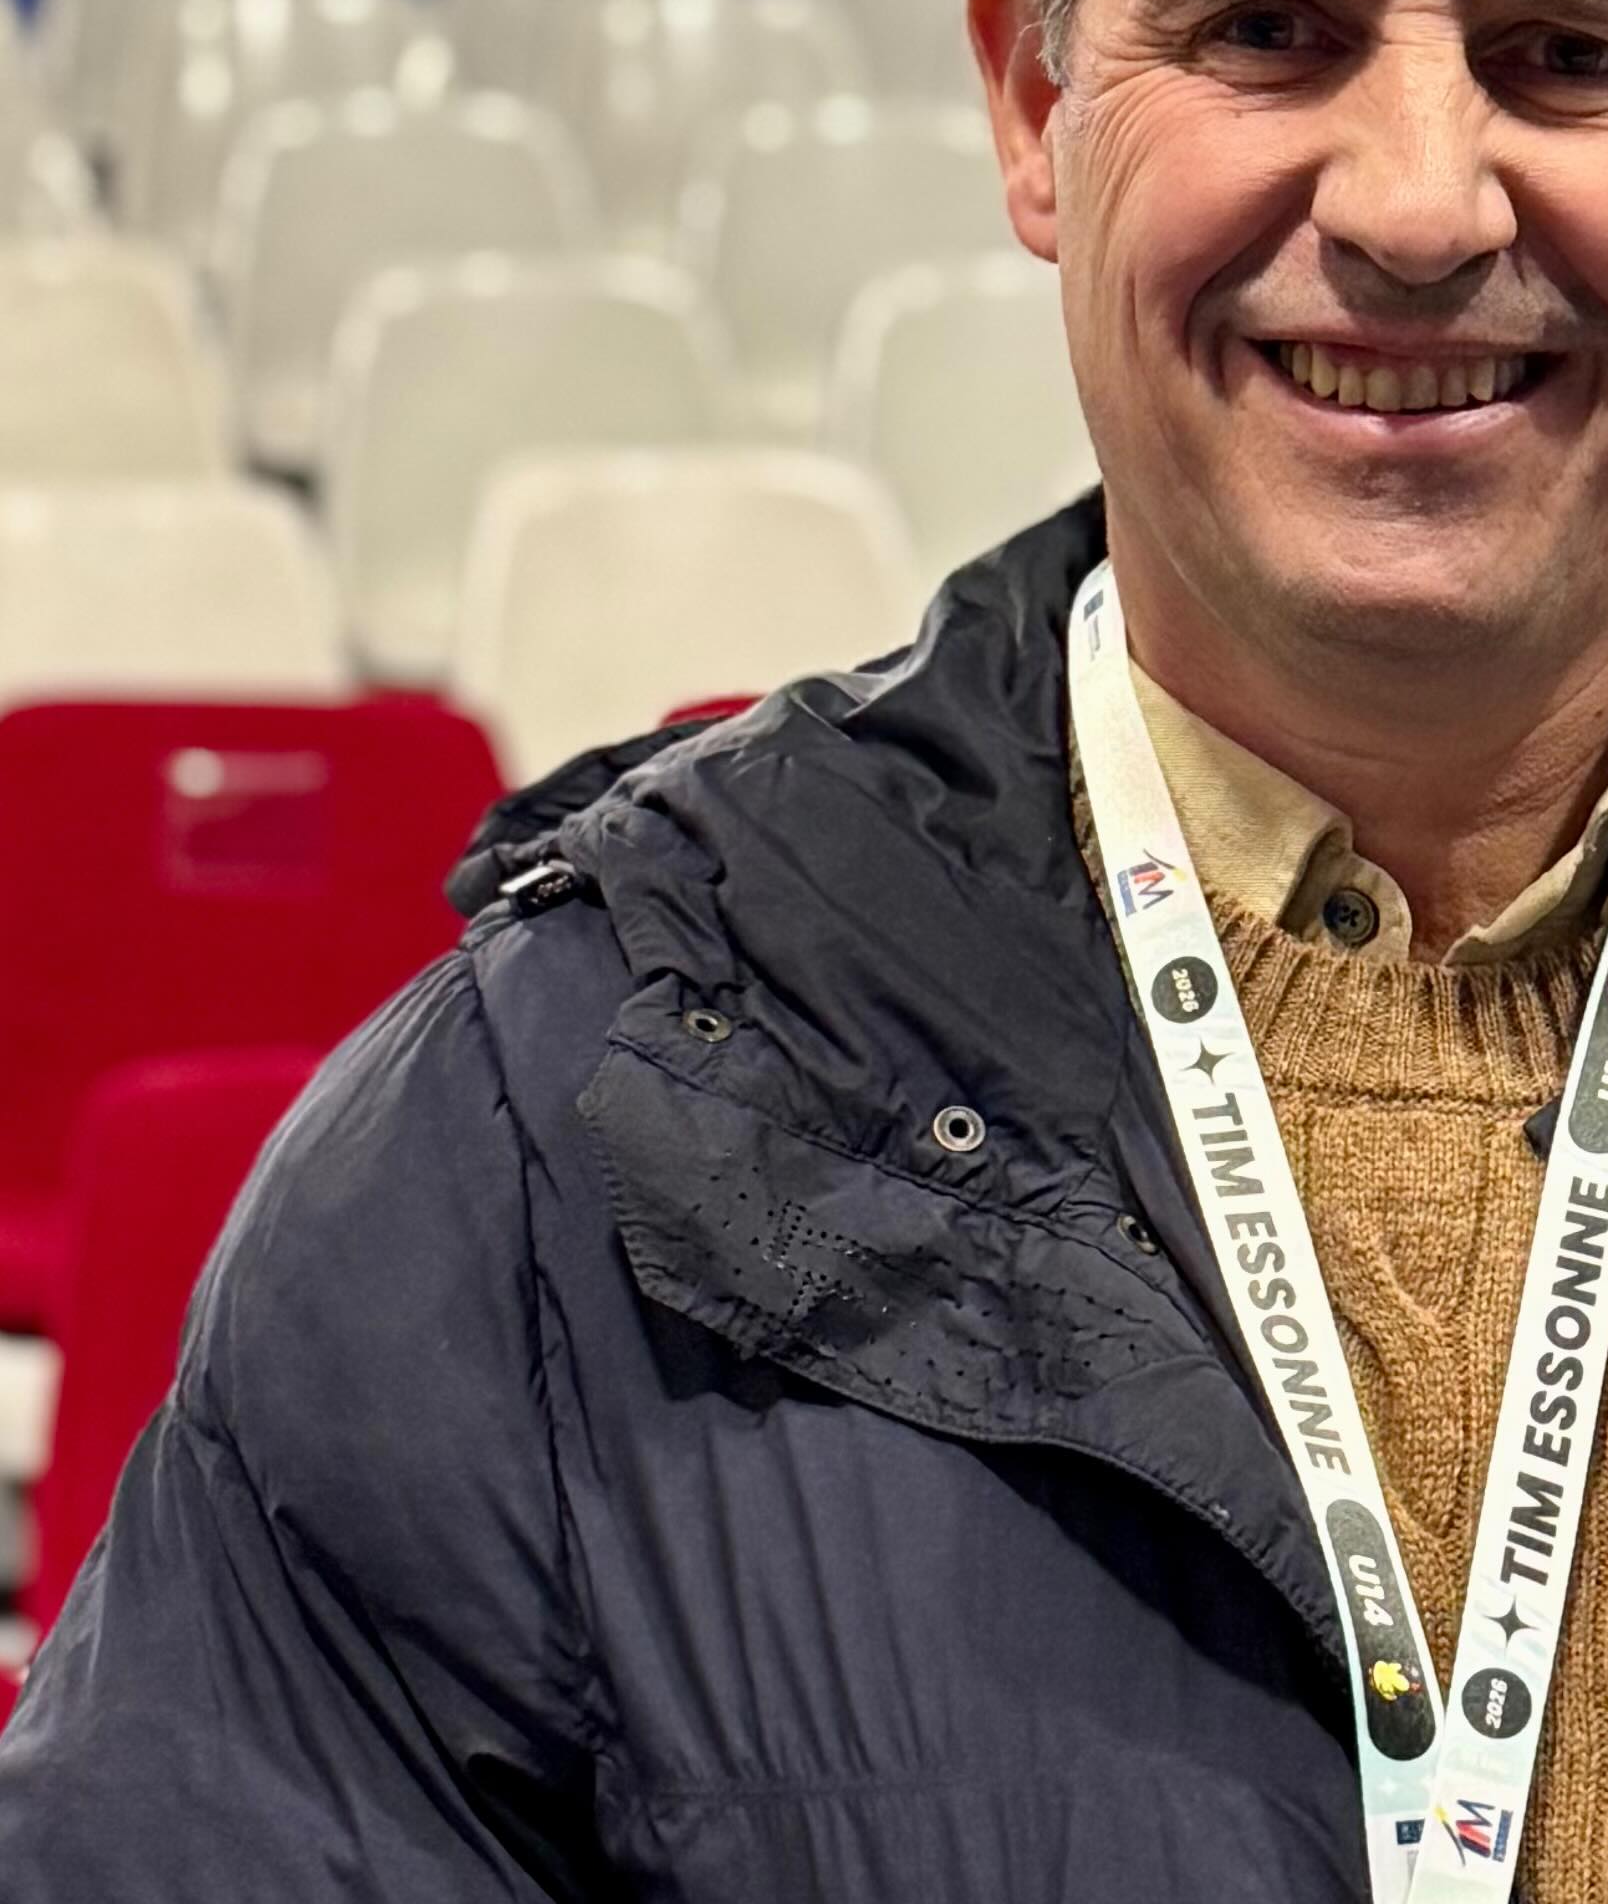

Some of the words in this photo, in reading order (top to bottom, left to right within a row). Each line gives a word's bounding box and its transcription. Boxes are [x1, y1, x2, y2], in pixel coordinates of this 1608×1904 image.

[1172, 967, 1200, 1013] 2026
[1192, 1092, 1265, 1198] TIM
[1224, 1211, 1352, 1476] ESSONNE
[1501, 1472, 1564, 1586] TIM
[1348, 1554, 1395, 1626] U14
[1485, 1677, 1509, 1730] 2026
